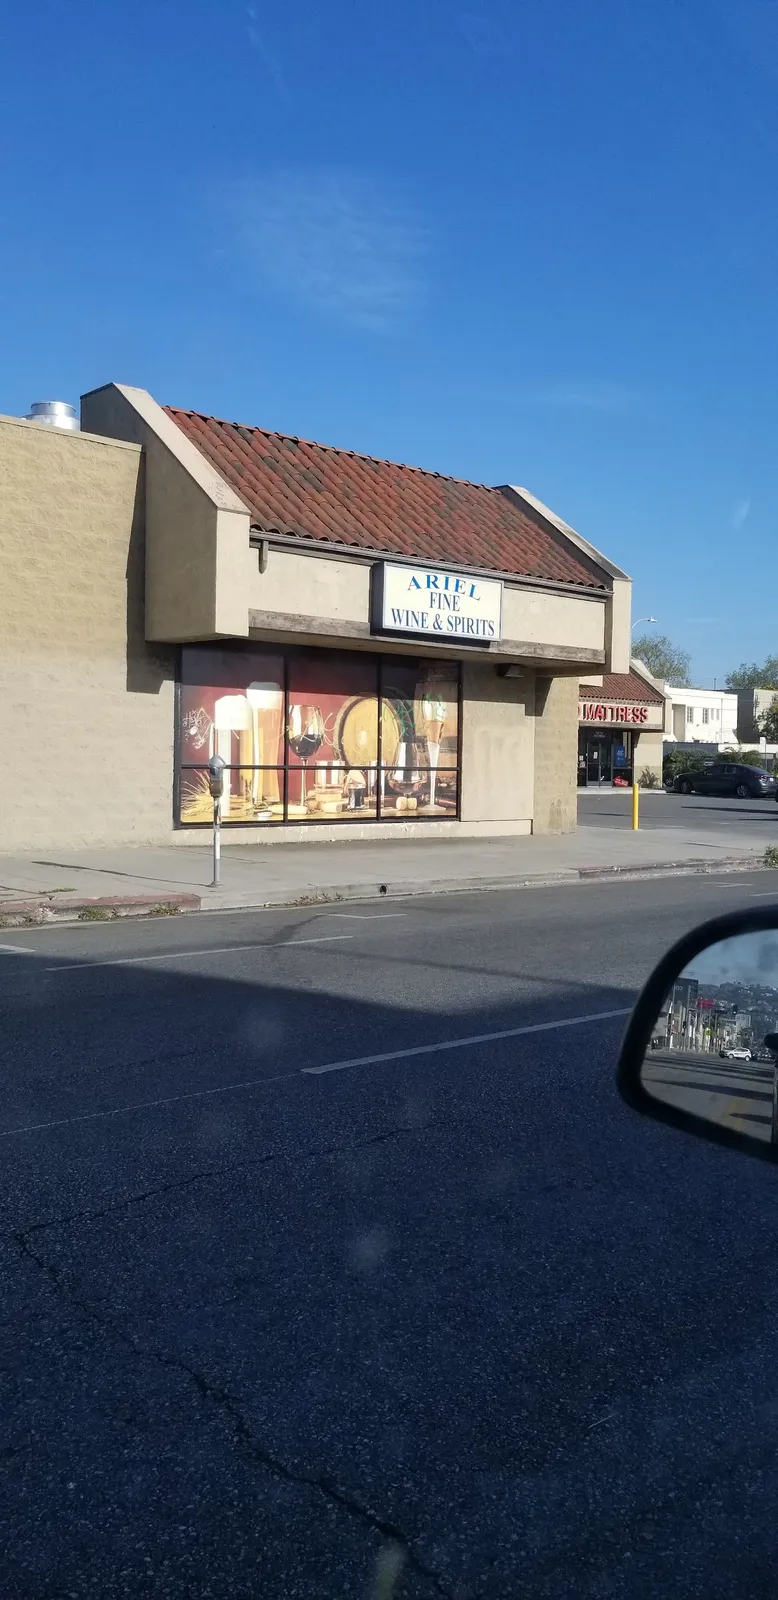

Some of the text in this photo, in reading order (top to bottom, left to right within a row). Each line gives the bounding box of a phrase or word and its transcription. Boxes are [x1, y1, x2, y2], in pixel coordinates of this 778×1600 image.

[407, 574, 481, 601] ARIEL
[429, 591, 460, 612] FINE
[391, 608, 495, 637] WINE & SPIRITS
[583, 703, 649, 723] MATTRESS
